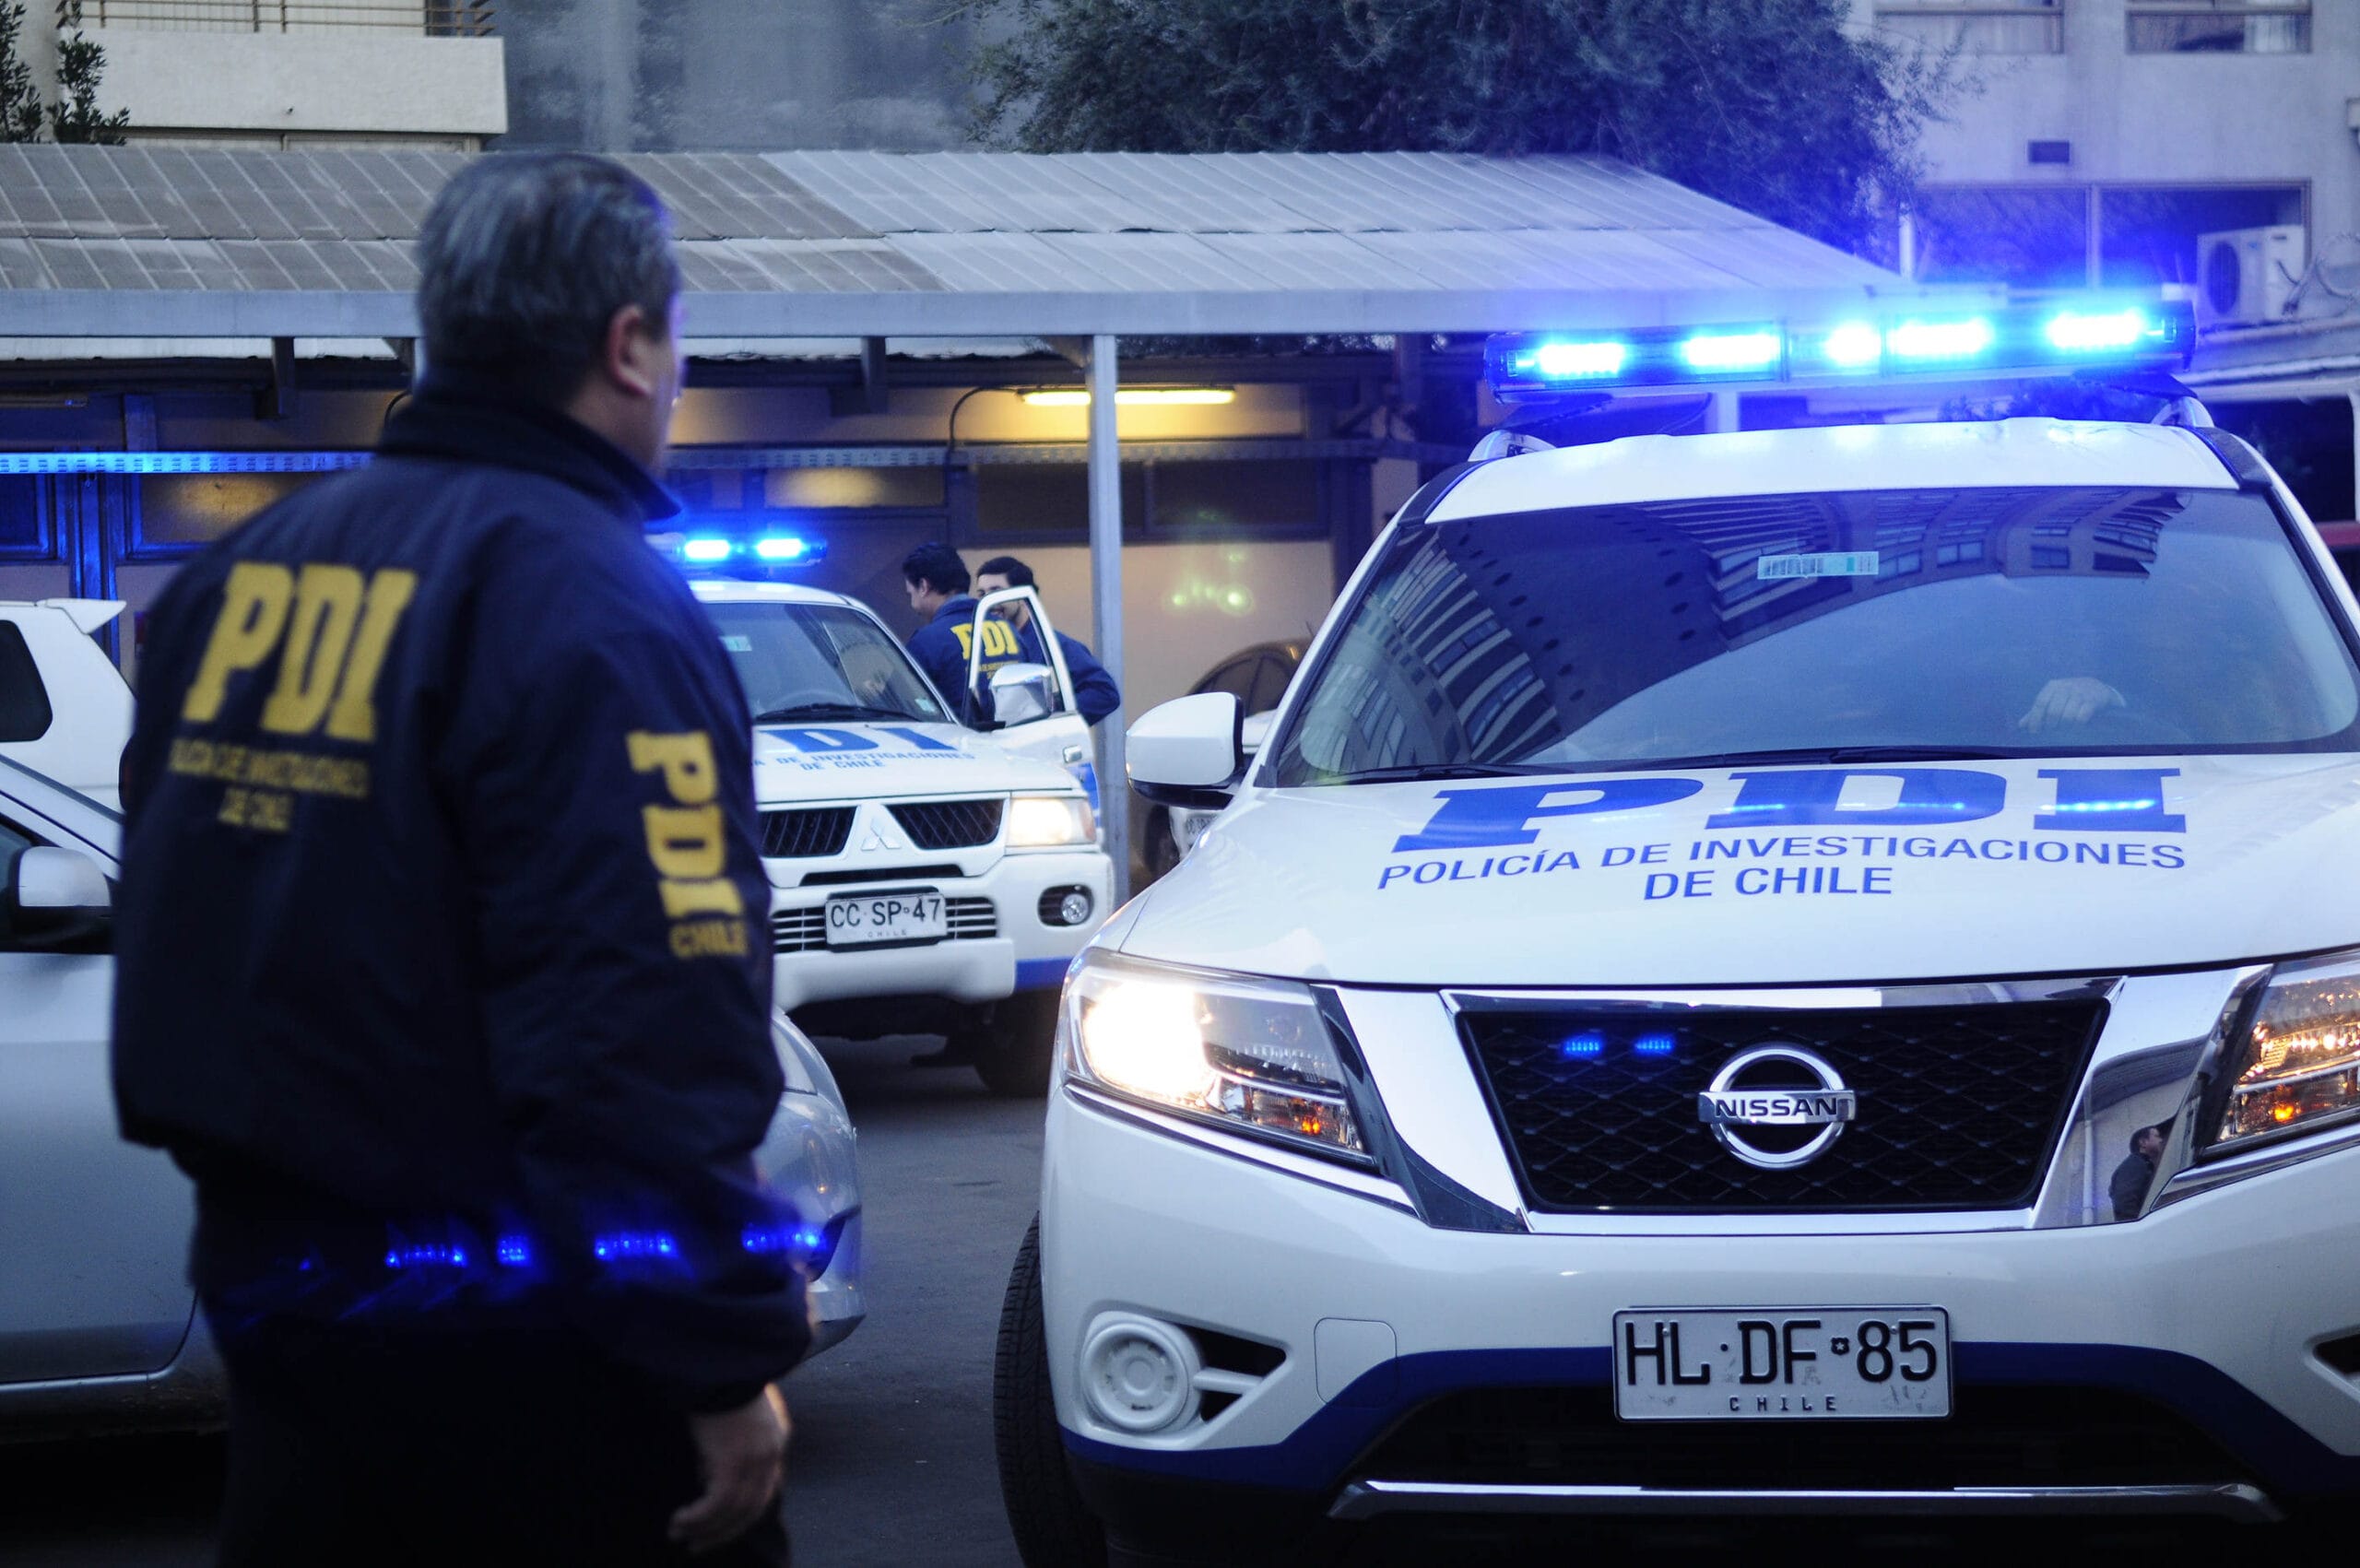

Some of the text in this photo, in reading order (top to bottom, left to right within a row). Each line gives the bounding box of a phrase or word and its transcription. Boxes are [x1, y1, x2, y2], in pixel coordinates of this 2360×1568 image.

[182, 560, 419, 741] PDI
[757, 727, 958, 753] DI
[625, 731, 744, 917] PDI
[1391, 768, 2187, 853] PDI
[1377, 835, 2186, 890] POLICÍA DE INVESTIGACIONES
[1644, 866, 1892, 901] DE CHILE
[1715, 1097, 1837, 1117] NISSAN
[1729, 1396, 1837, 1412] CHILE
